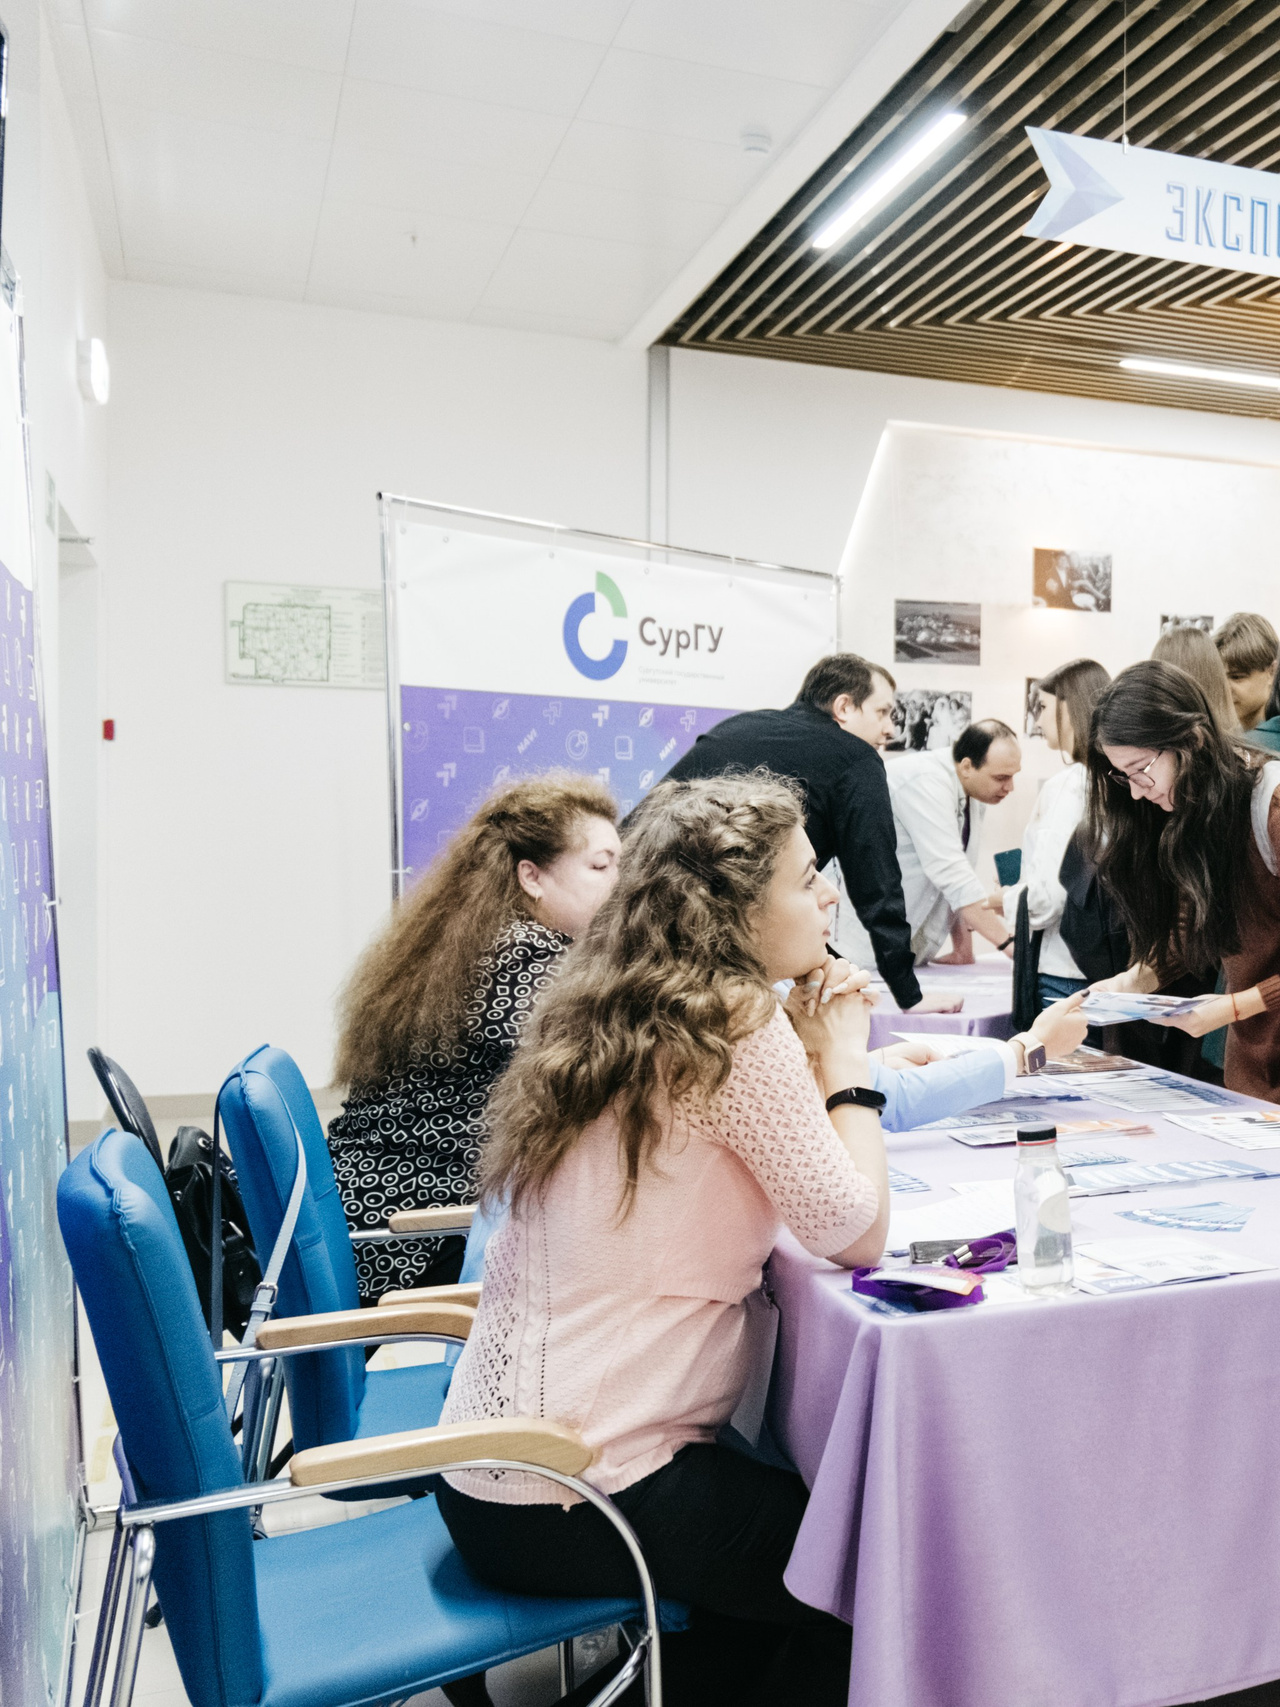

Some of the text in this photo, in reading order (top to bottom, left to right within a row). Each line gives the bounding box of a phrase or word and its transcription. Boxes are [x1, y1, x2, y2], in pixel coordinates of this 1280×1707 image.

[638, 616, 724, 659] СурГУ
[516, 728, 538, 755] NAVI
[658, 736, 677, 761] NAVI
